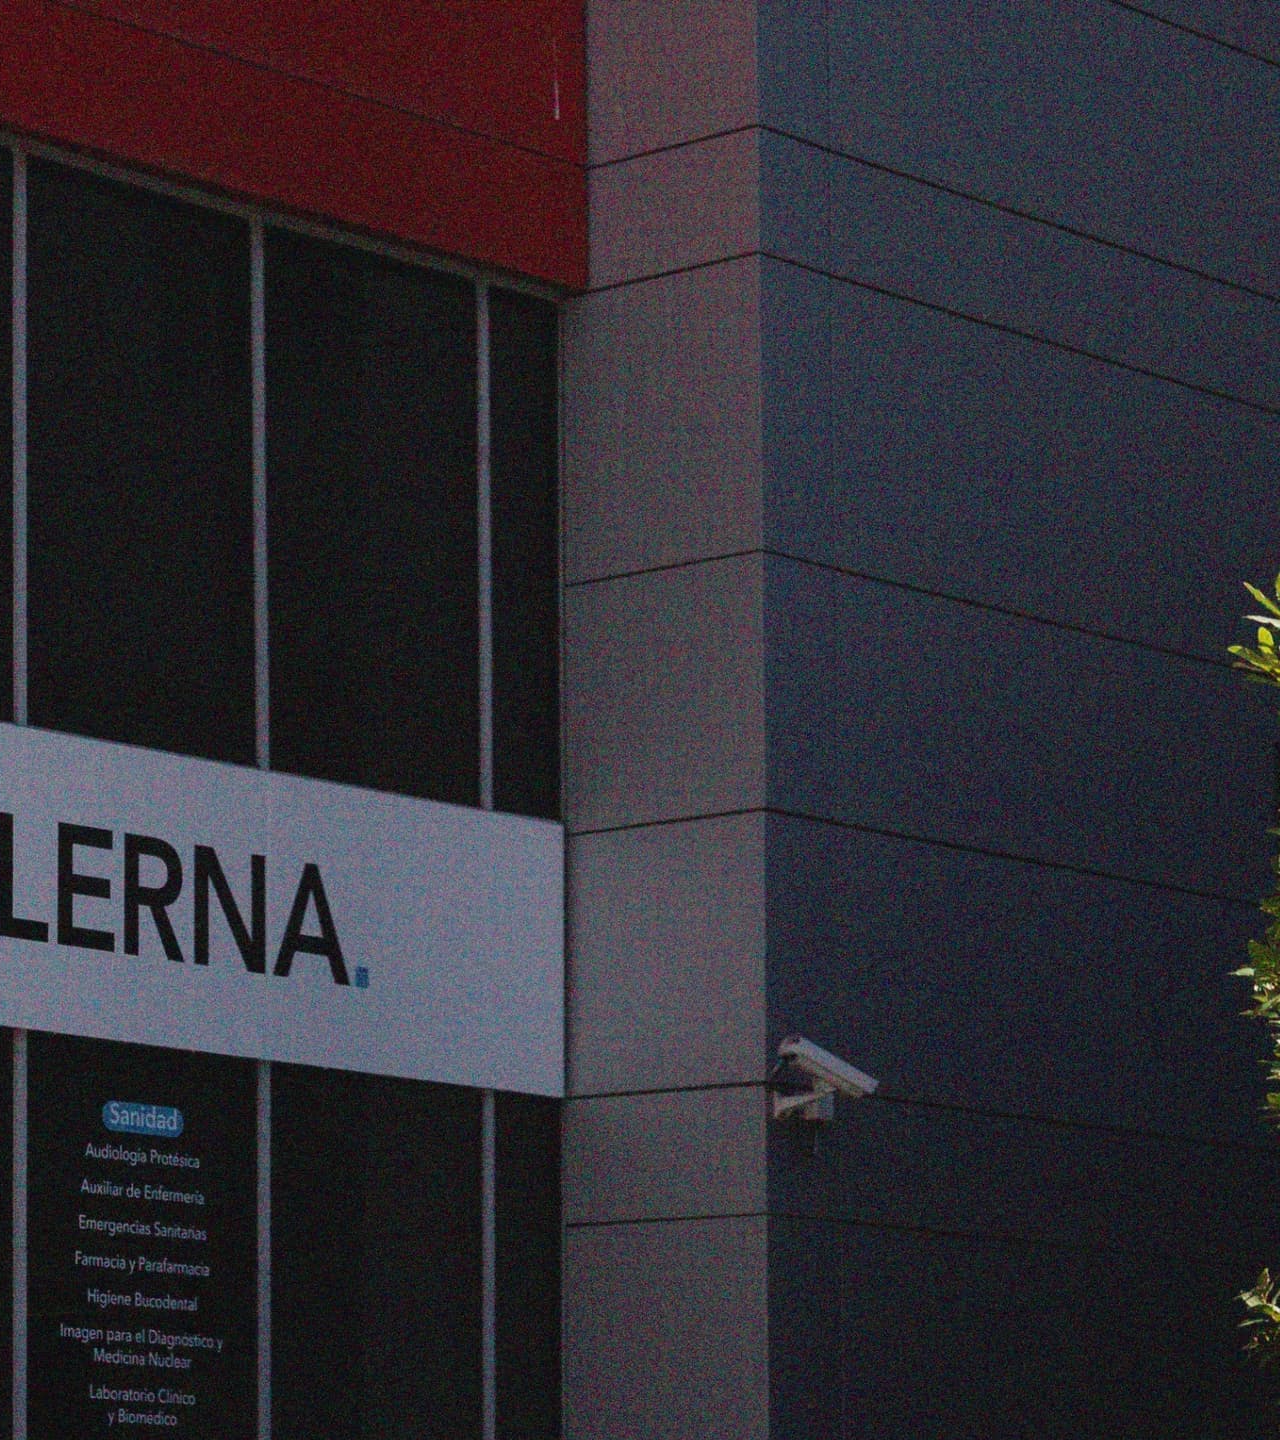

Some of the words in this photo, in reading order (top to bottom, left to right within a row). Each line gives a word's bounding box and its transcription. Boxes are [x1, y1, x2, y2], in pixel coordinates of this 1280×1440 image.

[110, 1102, 177, 1130] Sanidad
[150, 1150, 200, 1168] Protésica
[80, 1178, 123, 1197] Auxiliar
[126, 1183, 141, 1198] de
[78, 1214, 151, 1236] Emergencias
[154, 1221, 207, 1240] Sanitarias
[75, 1251, 126, 1269] Farmacia
[129, 1260, 135, 1274] y
[139, 1256, 210, 1277] Parafarmacia
[87, 1288, 131, 1308] Higiene
[135, 1292, 198, 1312] Bucodental
[60, 1323, 103, 1343] Imagen
[107, 1329, 132, 1344] para
[135, 1330, 145, 1344] el
[217, 1339, 223, 1352] y
[94, 1348, 145, 1366] Medicina
[149, 1351, 192, 1369] Nuclear
[90, 1384, 155, 1402] Laboratorio
[108, 1412, 114, 1426] y
